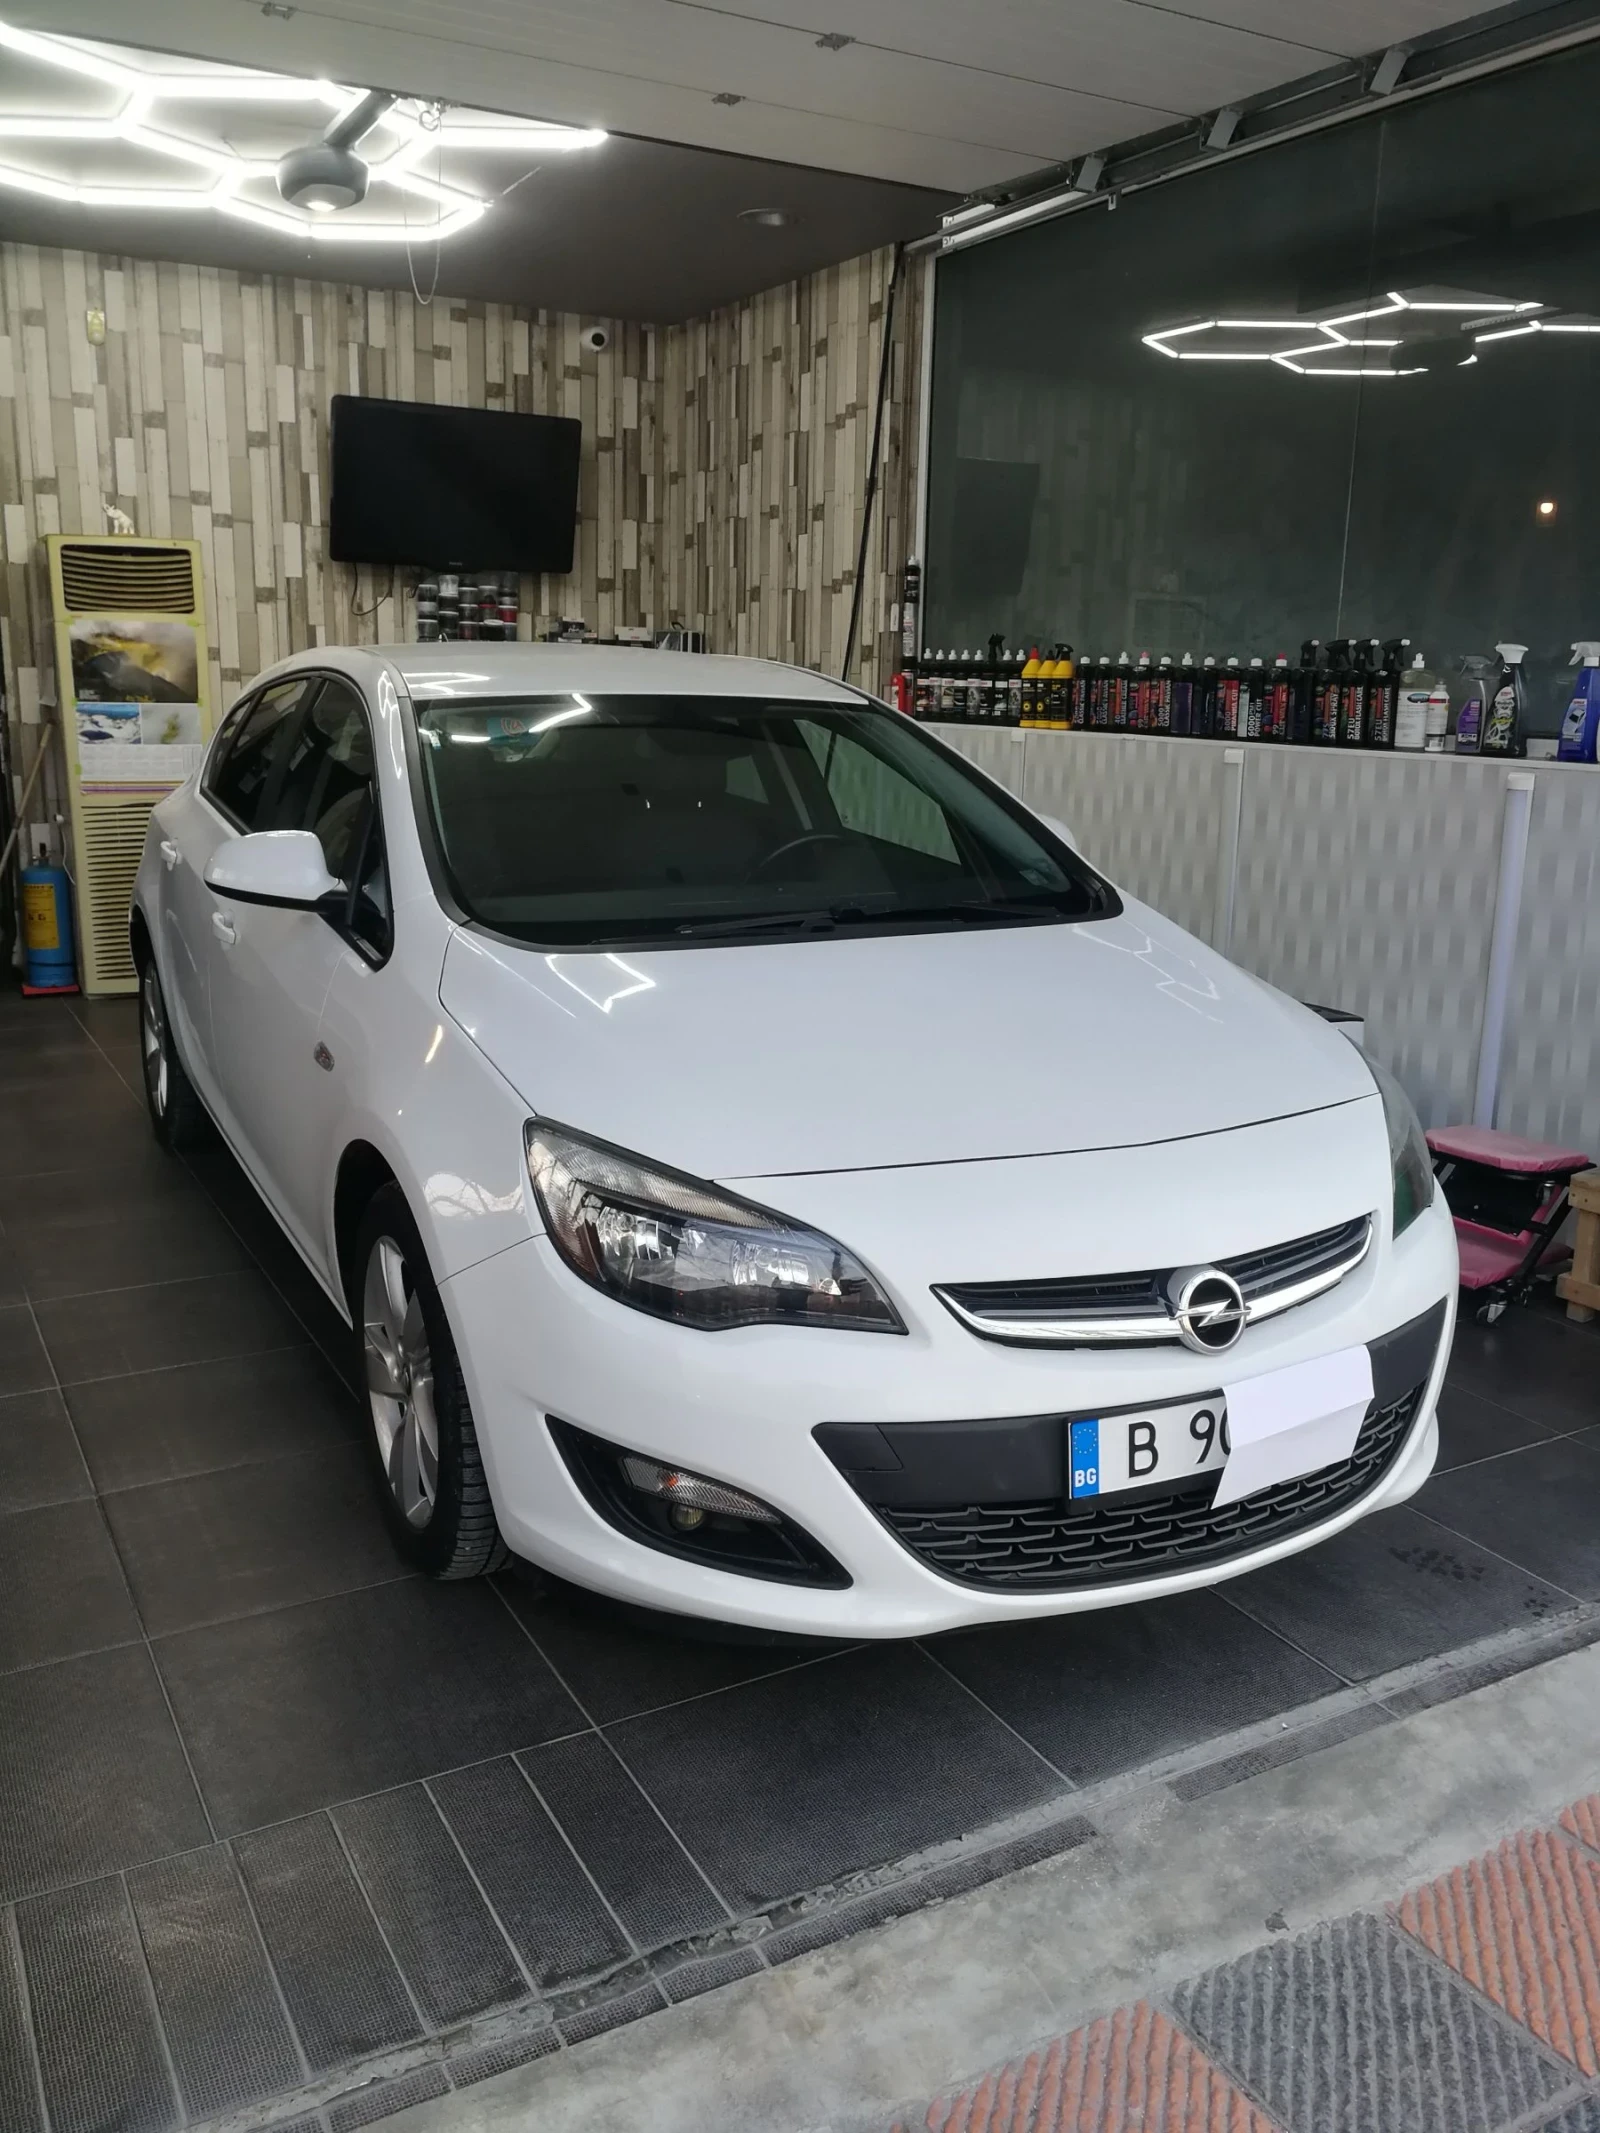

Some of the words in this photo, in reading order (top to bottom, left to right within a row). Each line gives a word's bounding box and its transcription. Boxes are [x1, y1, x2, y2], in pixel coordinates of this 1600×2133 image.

[1330, 692, 1339, 715] SPRAY
[1356, 686, 1364, 701] CARE
[1254, 713, 1262, 737] POWER
[1329, 717, 1337, 739] SIOUX
[1347, 718, 1355, 740] 57EU
[1374, 719, 1382, 741] 57EU
[1128, 1421, 1159, 1479] B
[1074, 1467, 1097, 1488] BG
